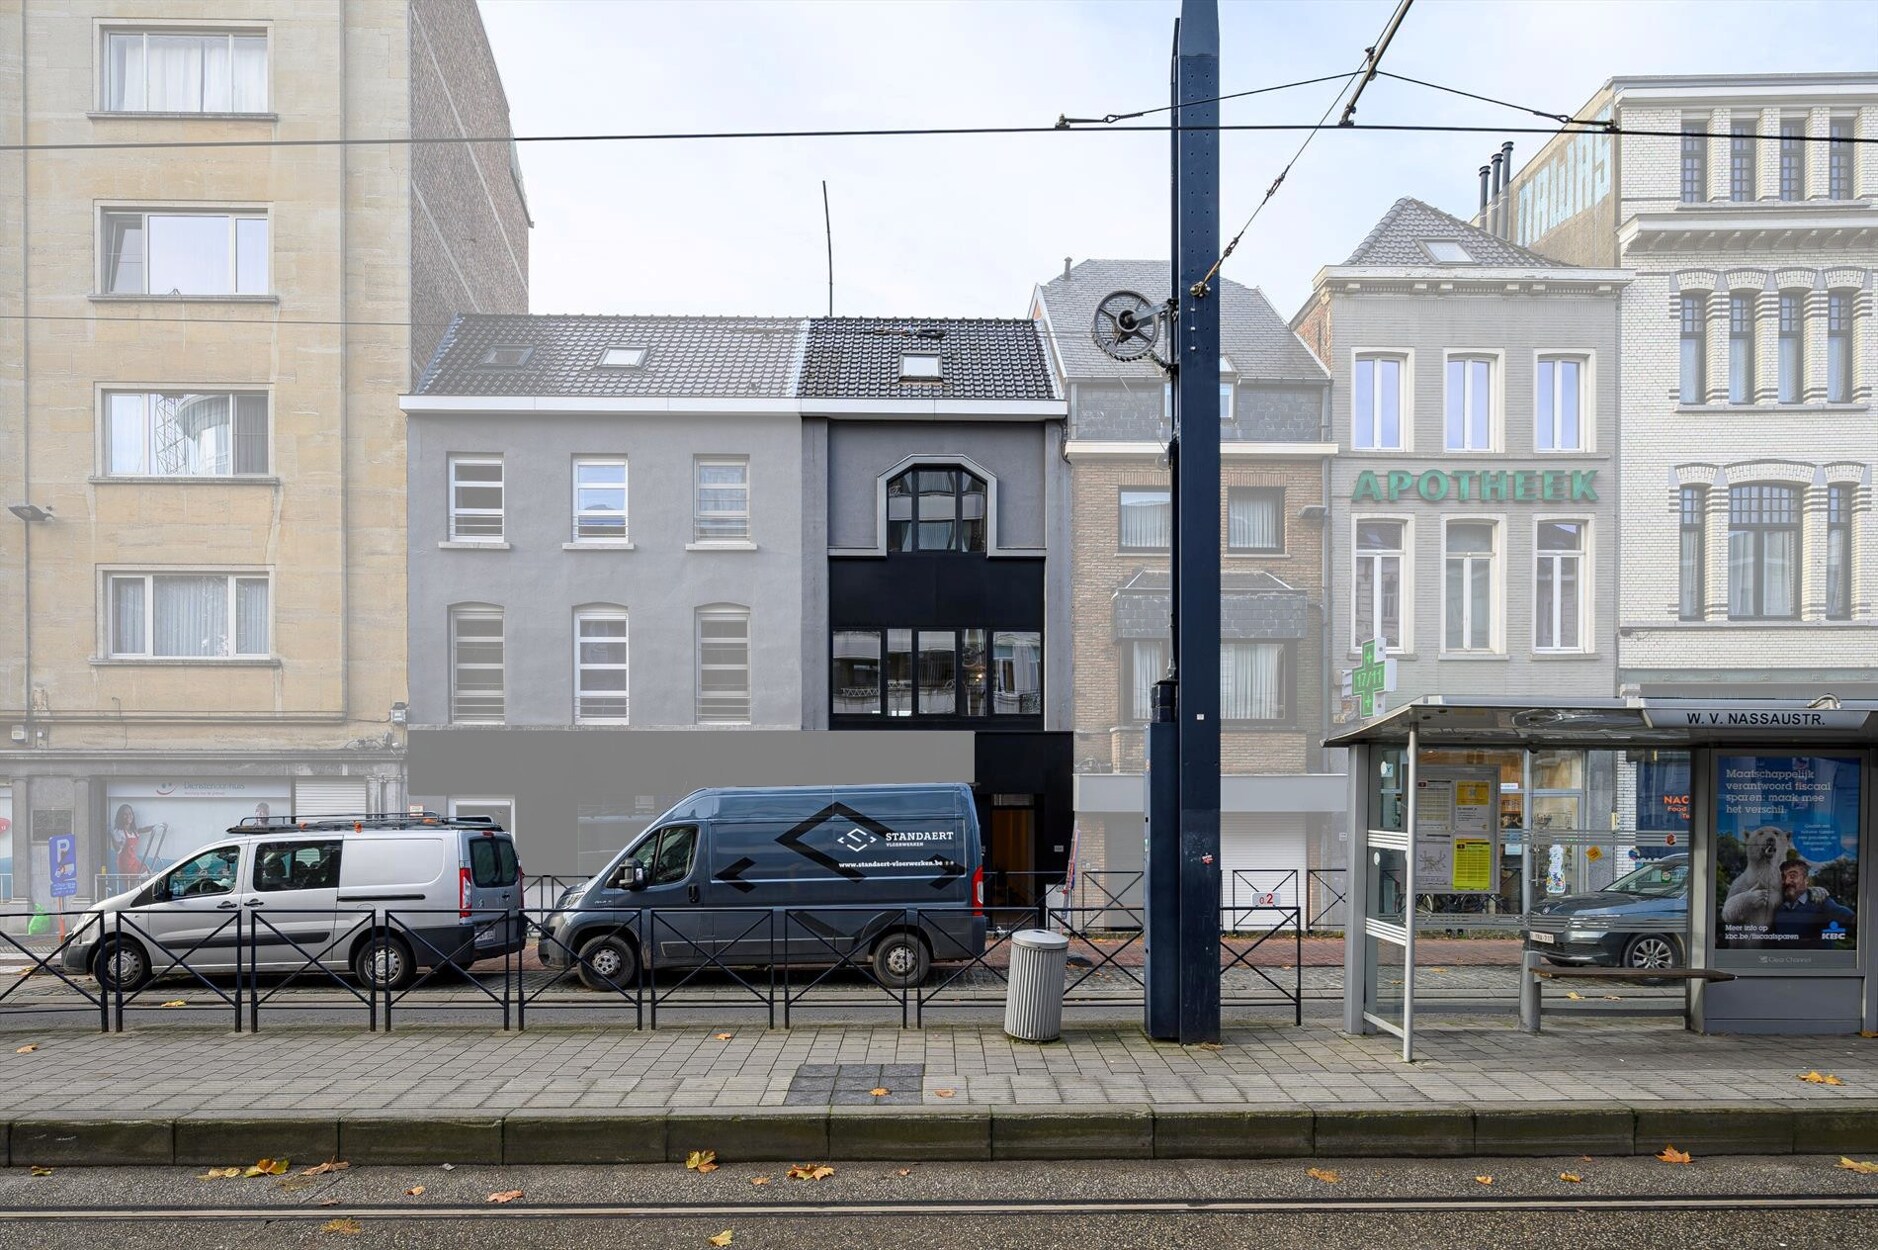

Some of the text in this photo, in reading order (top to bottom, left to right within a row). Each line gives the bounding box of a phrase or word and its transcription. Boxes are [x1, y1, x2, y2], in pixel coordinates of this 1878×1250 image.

[1350, 469, 1600, 503] APOTHEEK
[1357, 669, 1382, 688] 17/11
[1687, 712, 1826, 725] W. V. NASSAUSTR.
[1726, 769, 1815, 781] Maatschappelijk
[1726, 781, 1831, 791] verantwoord fiscaal
[1726, 794, 1766, 804] sparen:
[1768, 793, 1799, 802] maak
[1726, 804, 1787, 814] het verschil.
[885, 831, 954, 842] STANDAERT
[56, 838, 70, 864] P
[838, 859, 943, 869] www.standaert-vloerwerken.be
